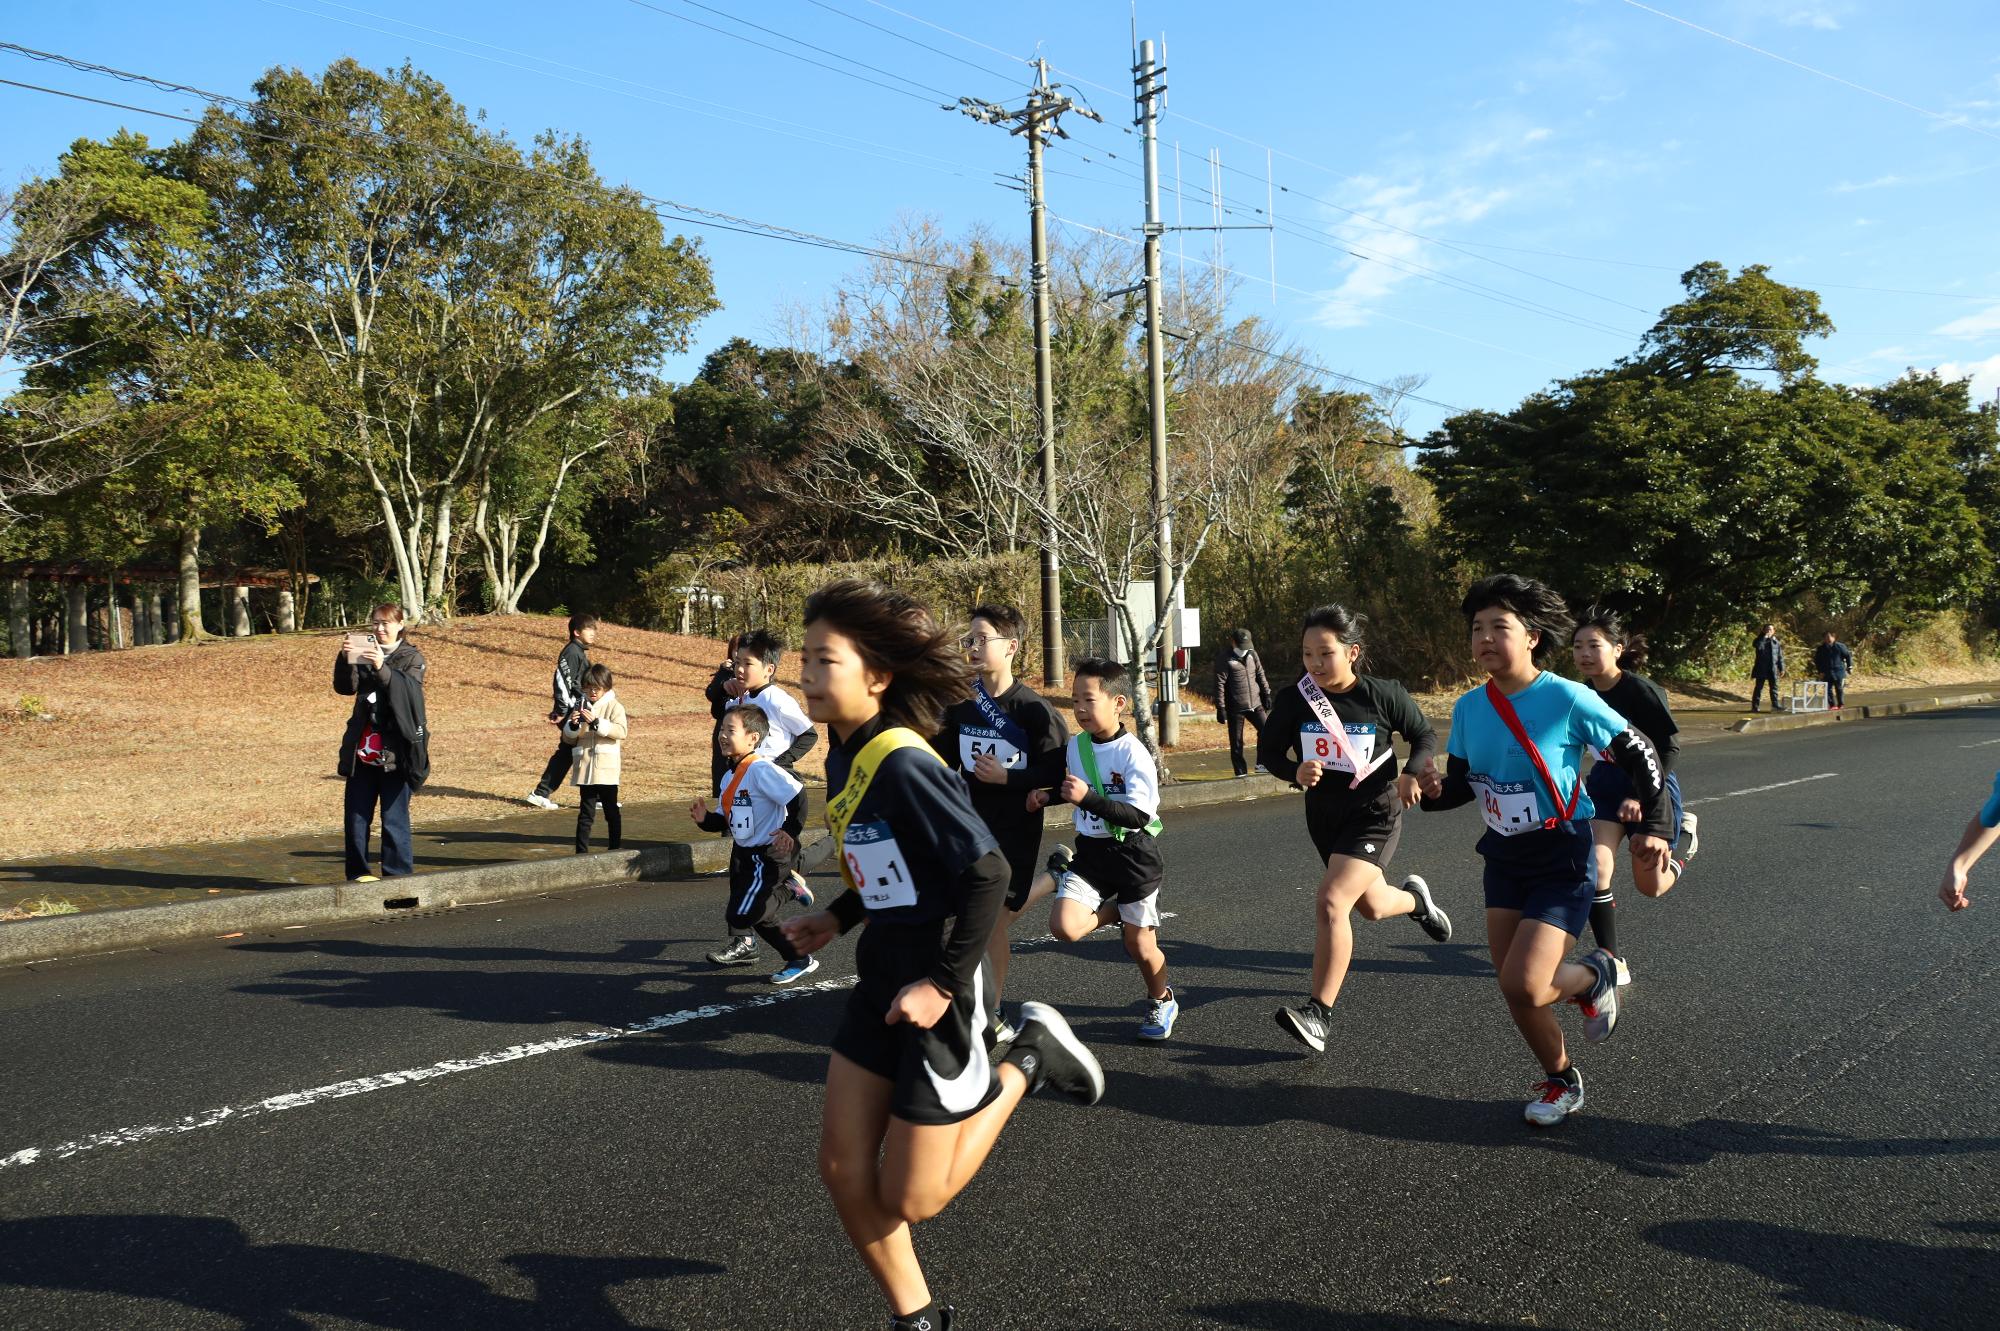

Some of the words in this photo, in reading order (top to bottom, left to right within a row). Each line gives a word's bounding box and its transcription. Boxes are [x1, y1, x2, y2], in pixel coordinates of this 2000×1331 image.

[970, 741, 996, 760] 54
[1364, 746, 1369, 760] 1
[1484, 789, 1502, 821] 84
[744, 816, 750, 829] 1
[1523, 806, 1532, 822] 1
[887, 860, 903, 883] 1
